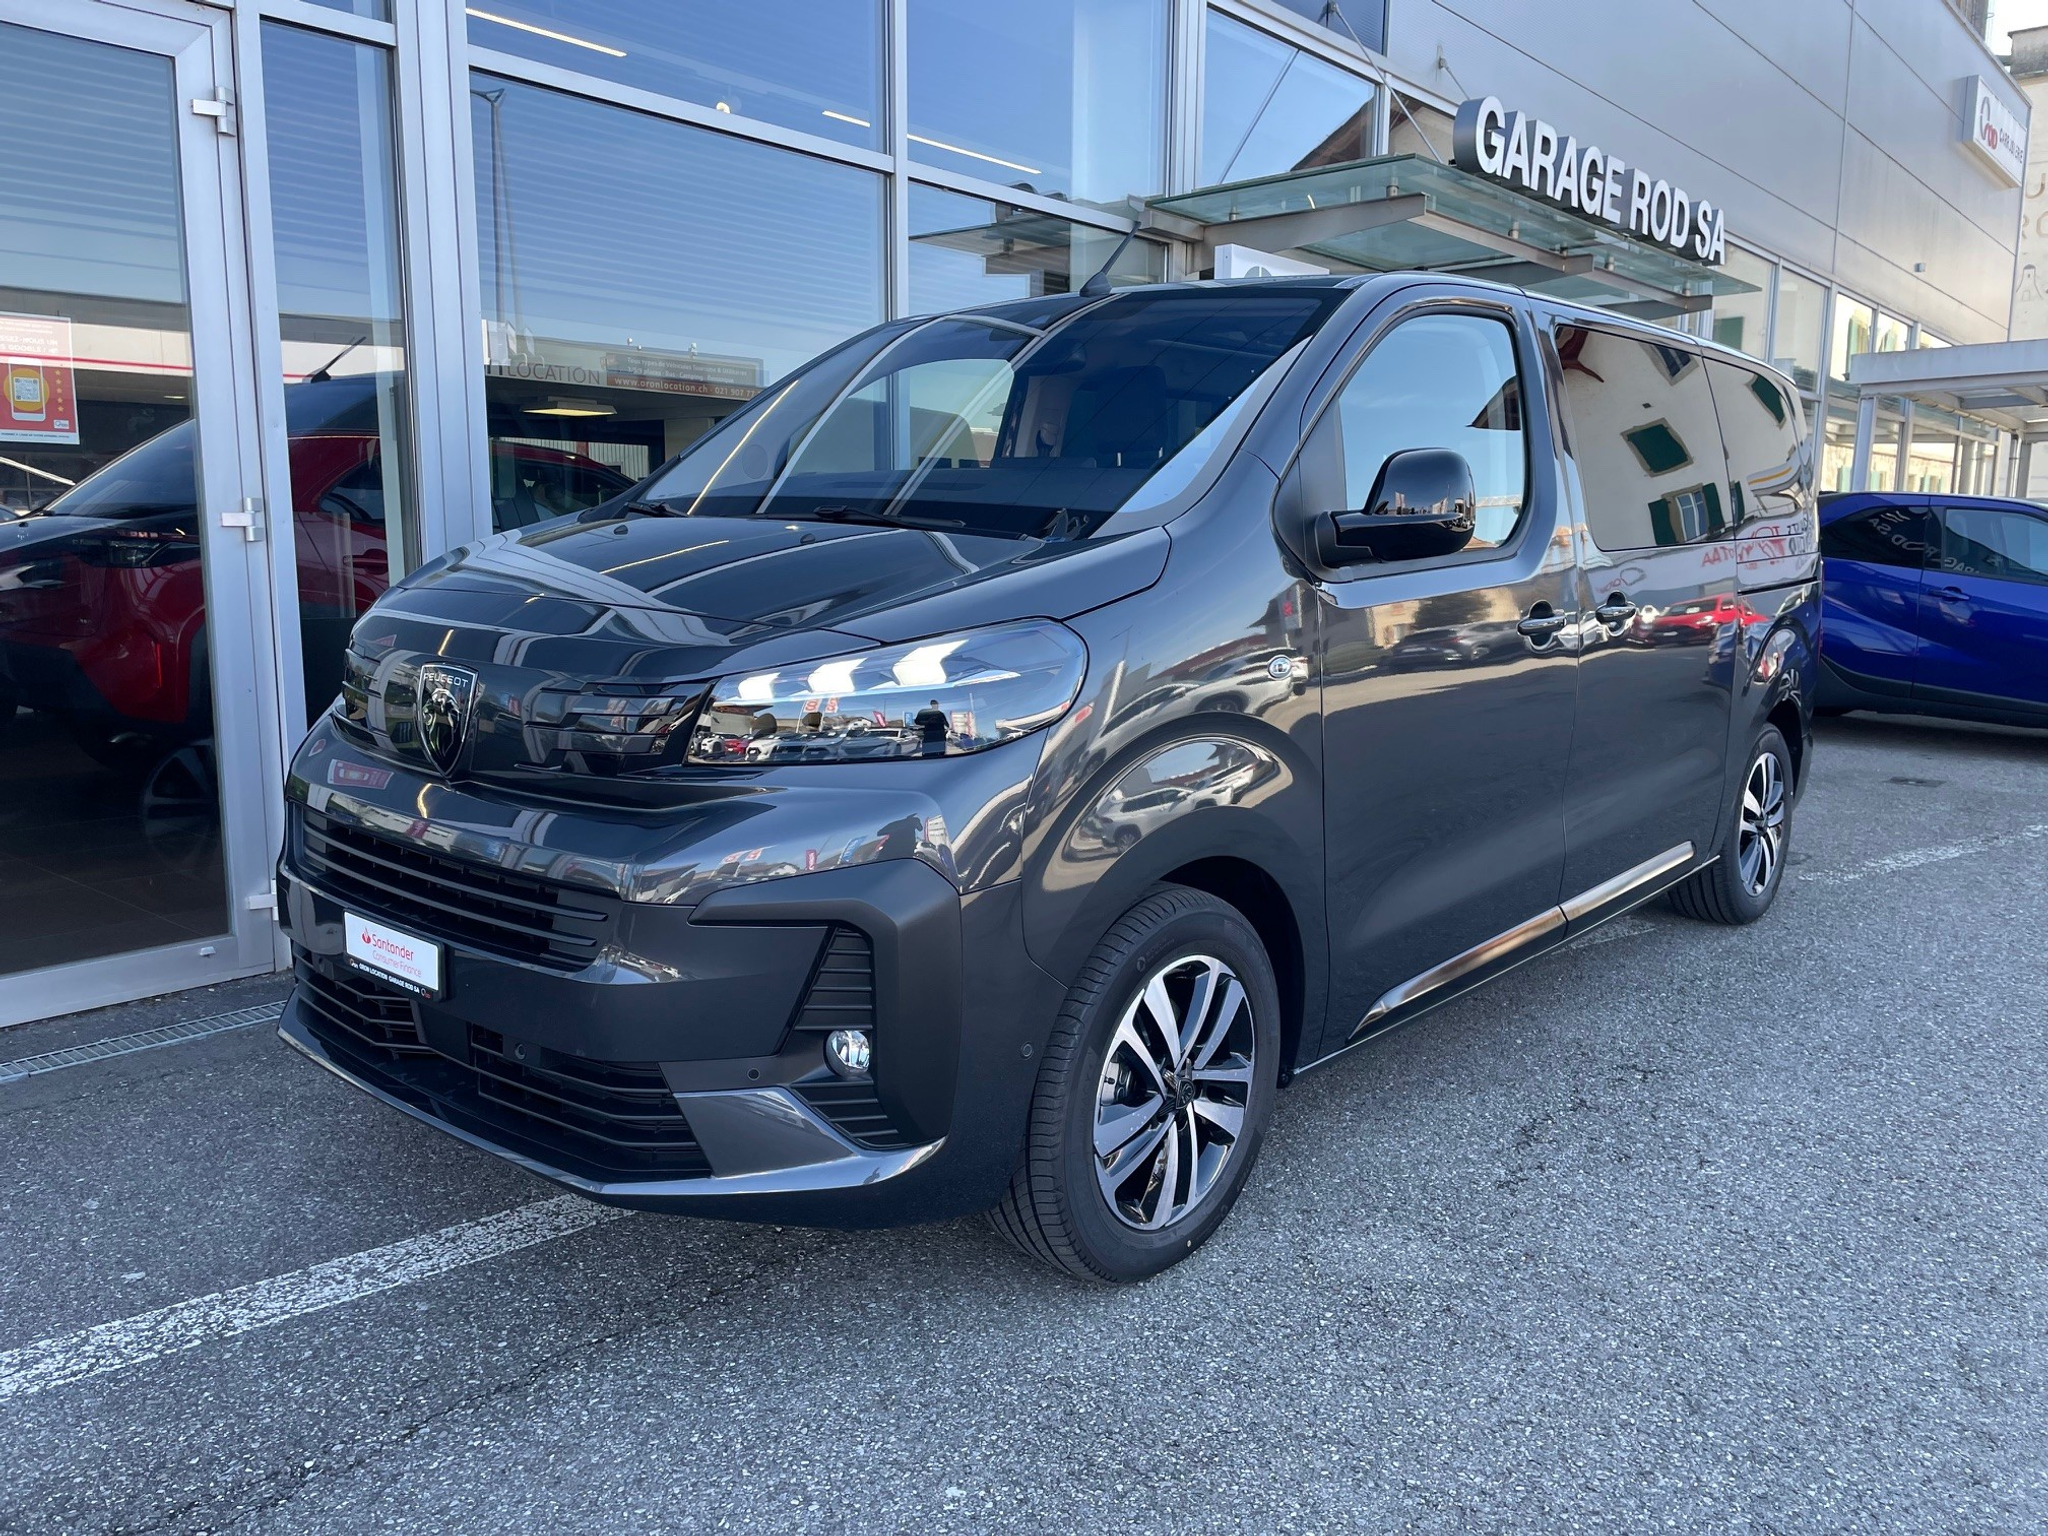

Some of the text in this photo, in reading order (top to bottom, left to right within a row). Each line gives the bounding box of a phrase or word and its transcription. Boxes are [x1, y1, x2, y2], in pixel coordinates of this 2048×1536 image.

[1476, 95, 1726, 265] GARAGE ROD SA
[507, 361, 600, 385] LOCATION
[614, 377, 708, 393] www.oronlocation.ch
[714, 386, 728, 395] 021
[730, 388, 744, 397] 907
[423, 671, 469, 688] PEUGEOT
[372, 933, 414, 961] Santander
